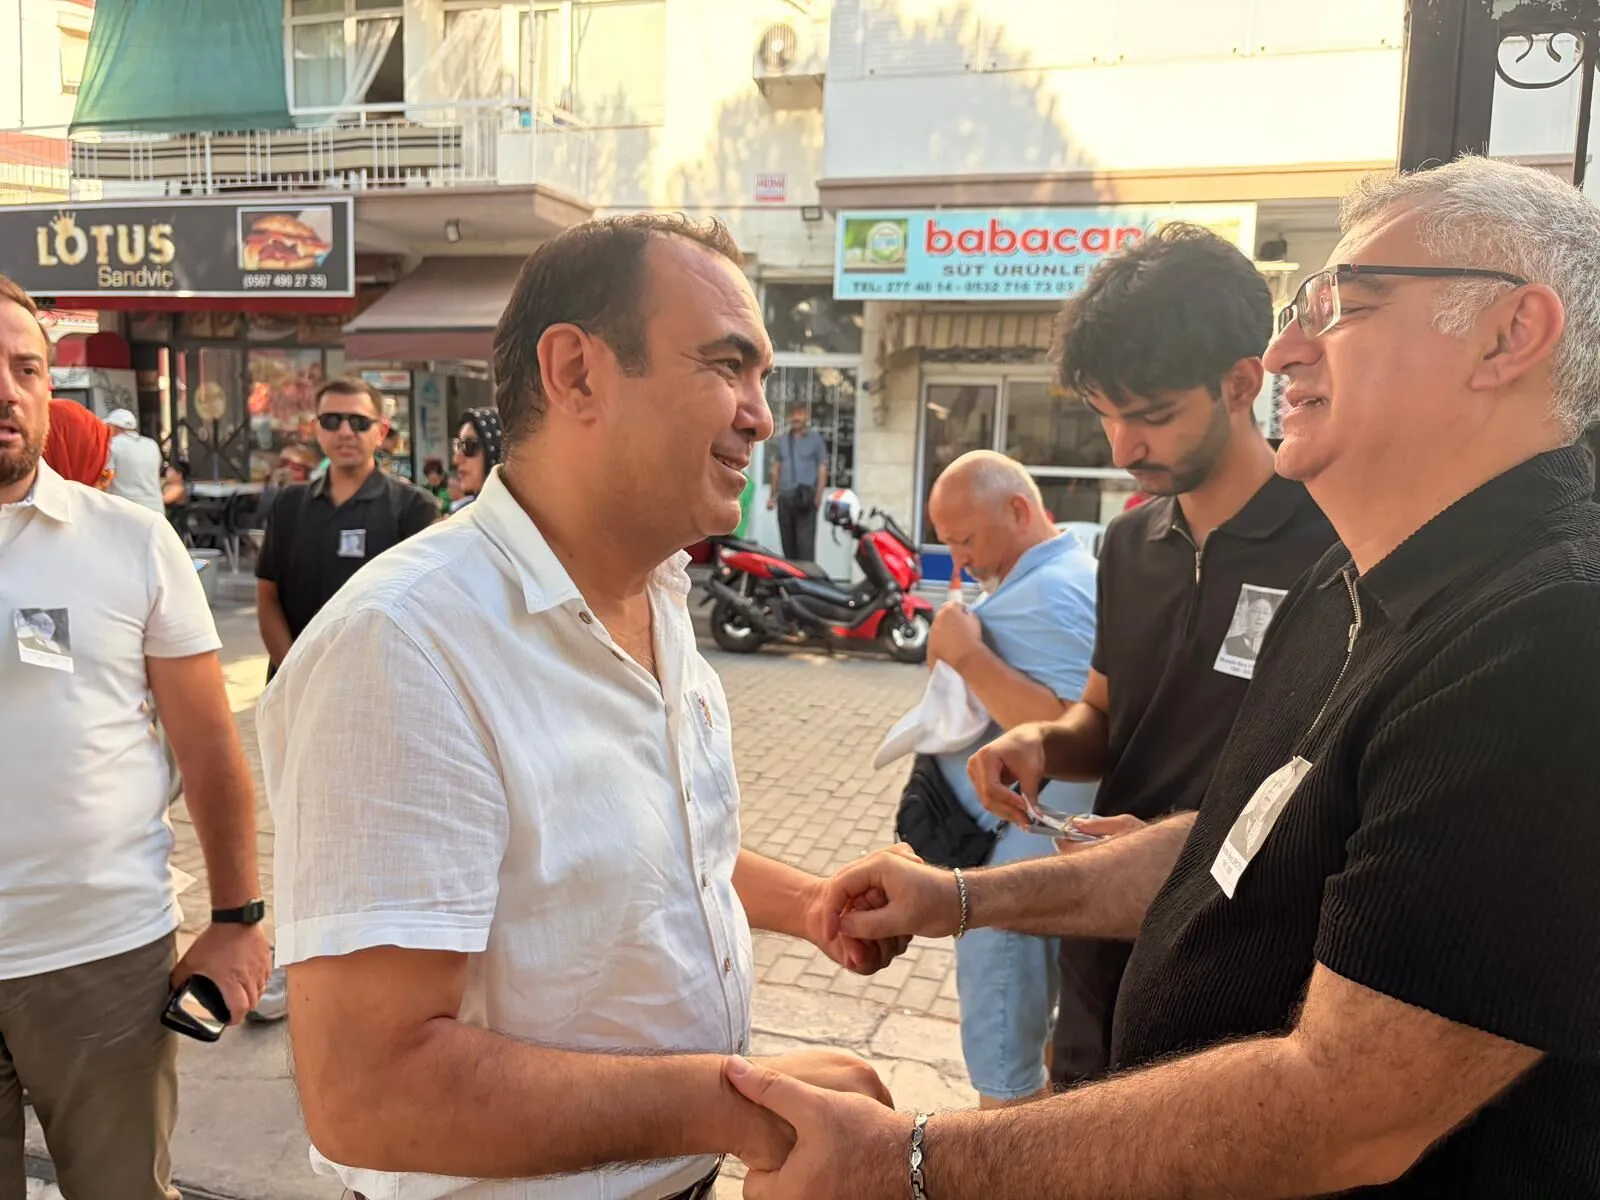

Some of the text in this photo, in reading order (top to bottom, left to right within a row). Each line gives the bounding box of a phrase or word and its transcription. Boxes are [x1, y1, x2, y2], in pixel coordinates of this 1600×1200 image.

[36, 220, 176, 266] LOTUS
[97, 265, 174, 288] Sandviç
[943, 262, 1096, 277] SÜT ÜRÜNLE
[853, 281, 883, 294] TEL:
[887, 281, 910, 294] 277
[964, 281, 999, 294] 0532
